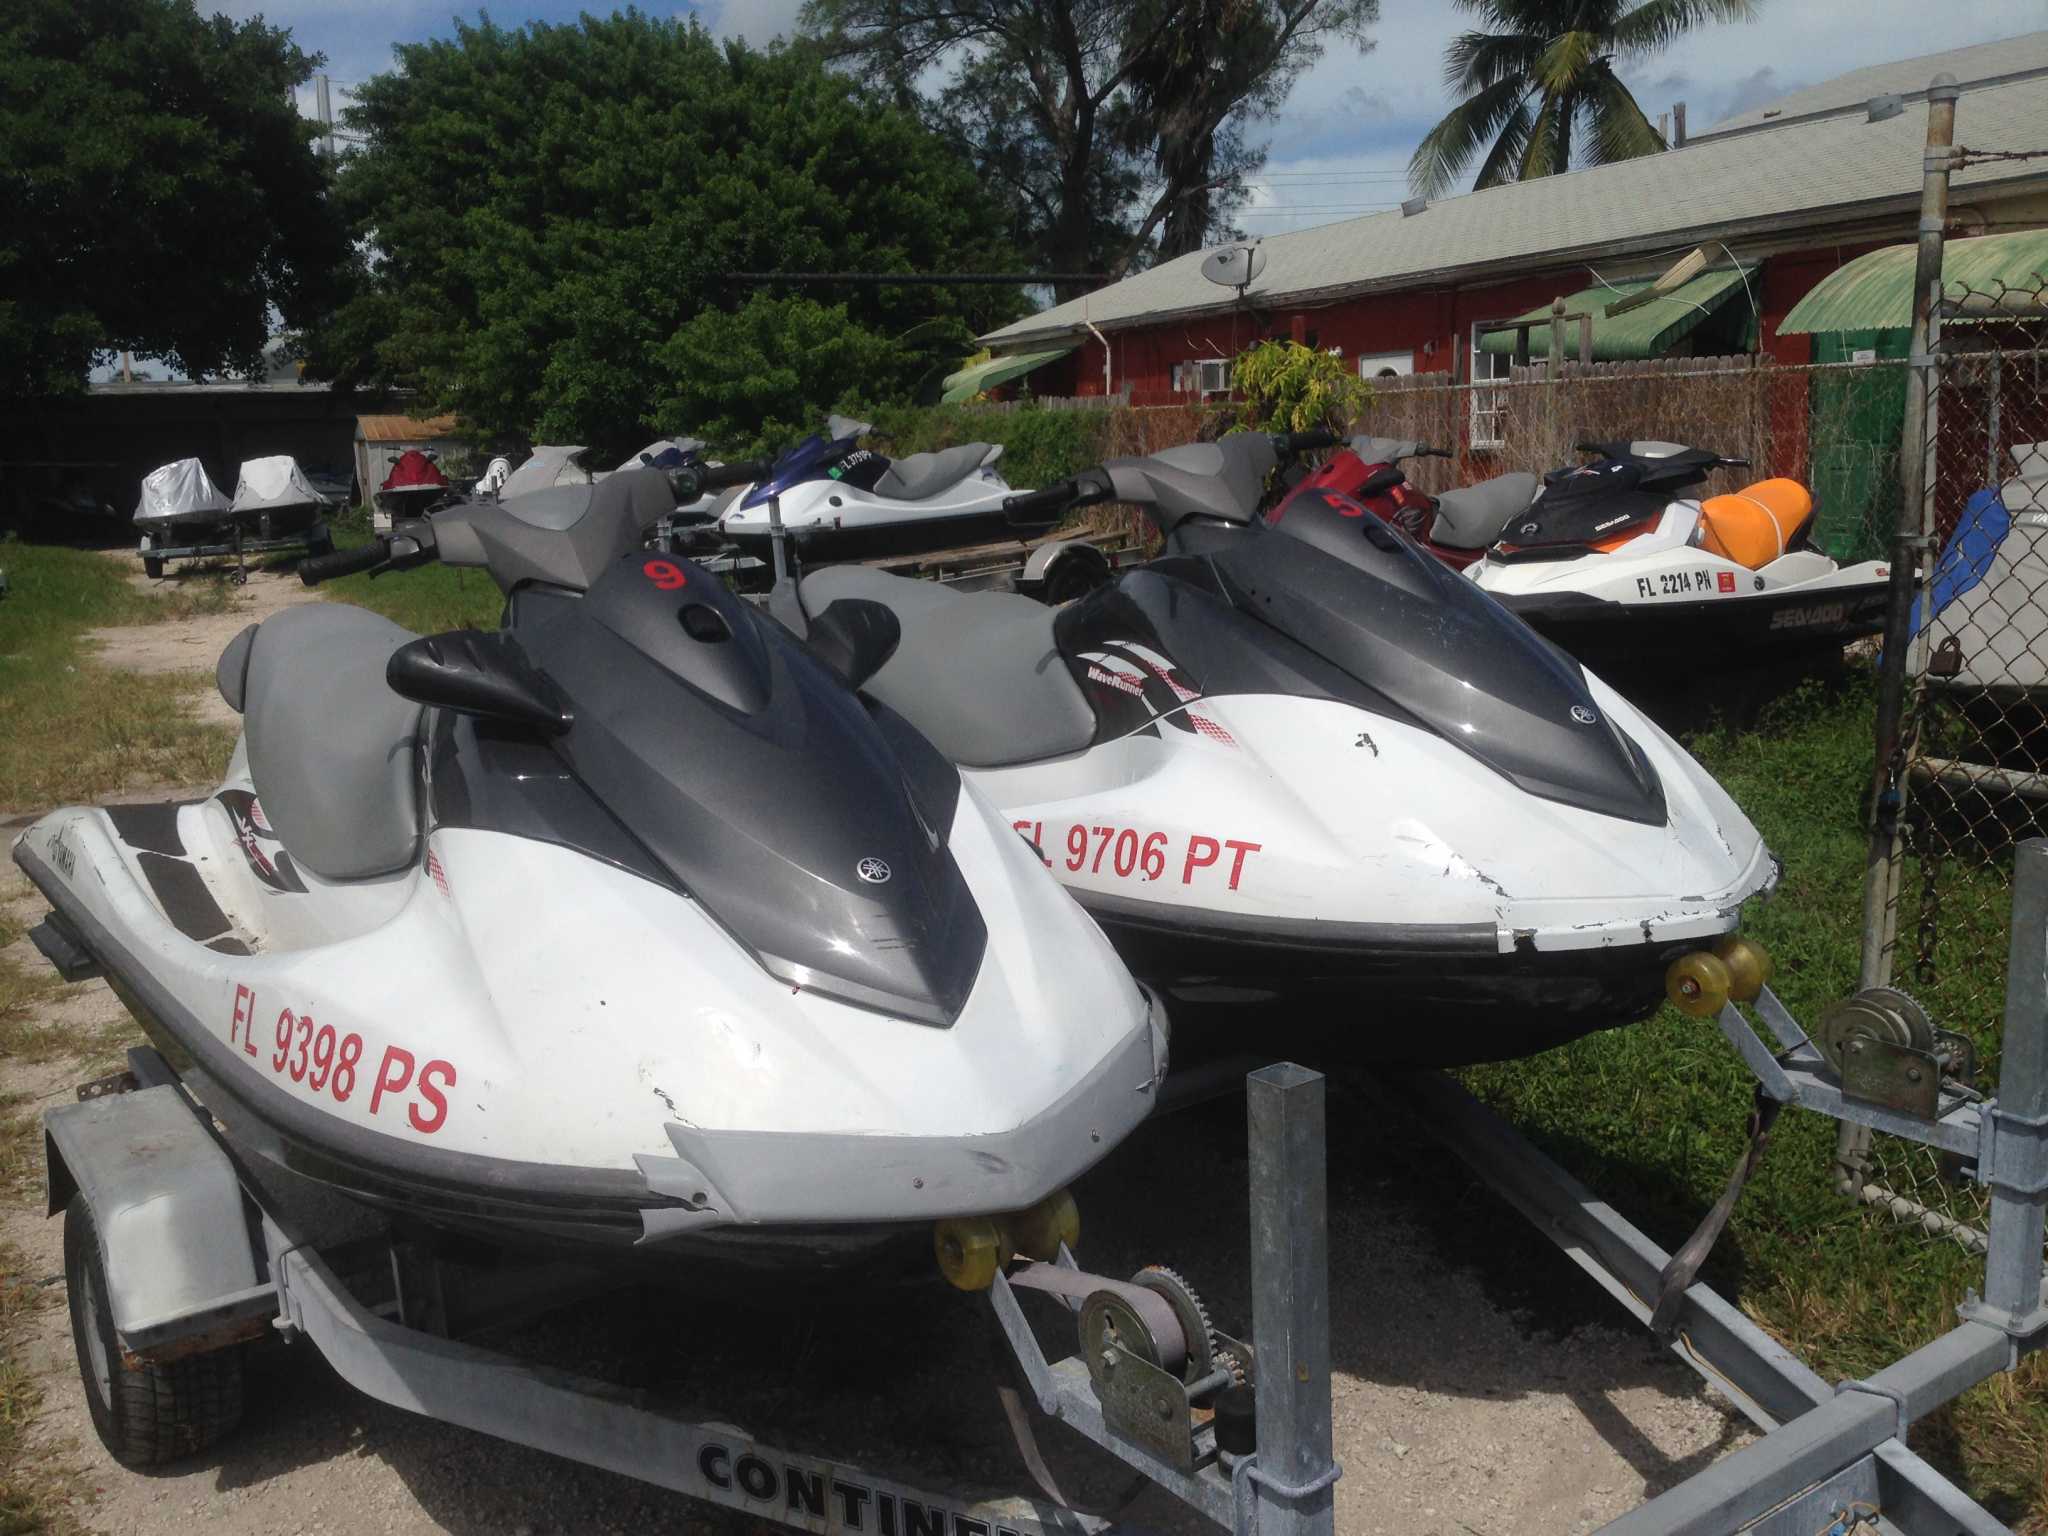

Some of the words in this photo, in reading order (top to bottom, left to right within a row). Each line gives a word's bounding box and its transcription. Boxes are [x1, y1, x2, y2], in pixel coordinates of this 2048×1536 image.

[1322, 493, 1362, 516] 5
[643, 560, 686, 590] 9
[1637, 577, 1656, 598] FL
[1660, 572, 1692, 594] 2214
[1695, 570, 1712, 591] PN
[1013, 820, 1052, 869] L
[1066, 823, 1168, 881] 9706
[1182, 834, 1262, 891] PT
[231, 983, 258, 1058] FL
[272, 1007, 363, 1102] 9398
[369, 1044, 457, 1134] PS
